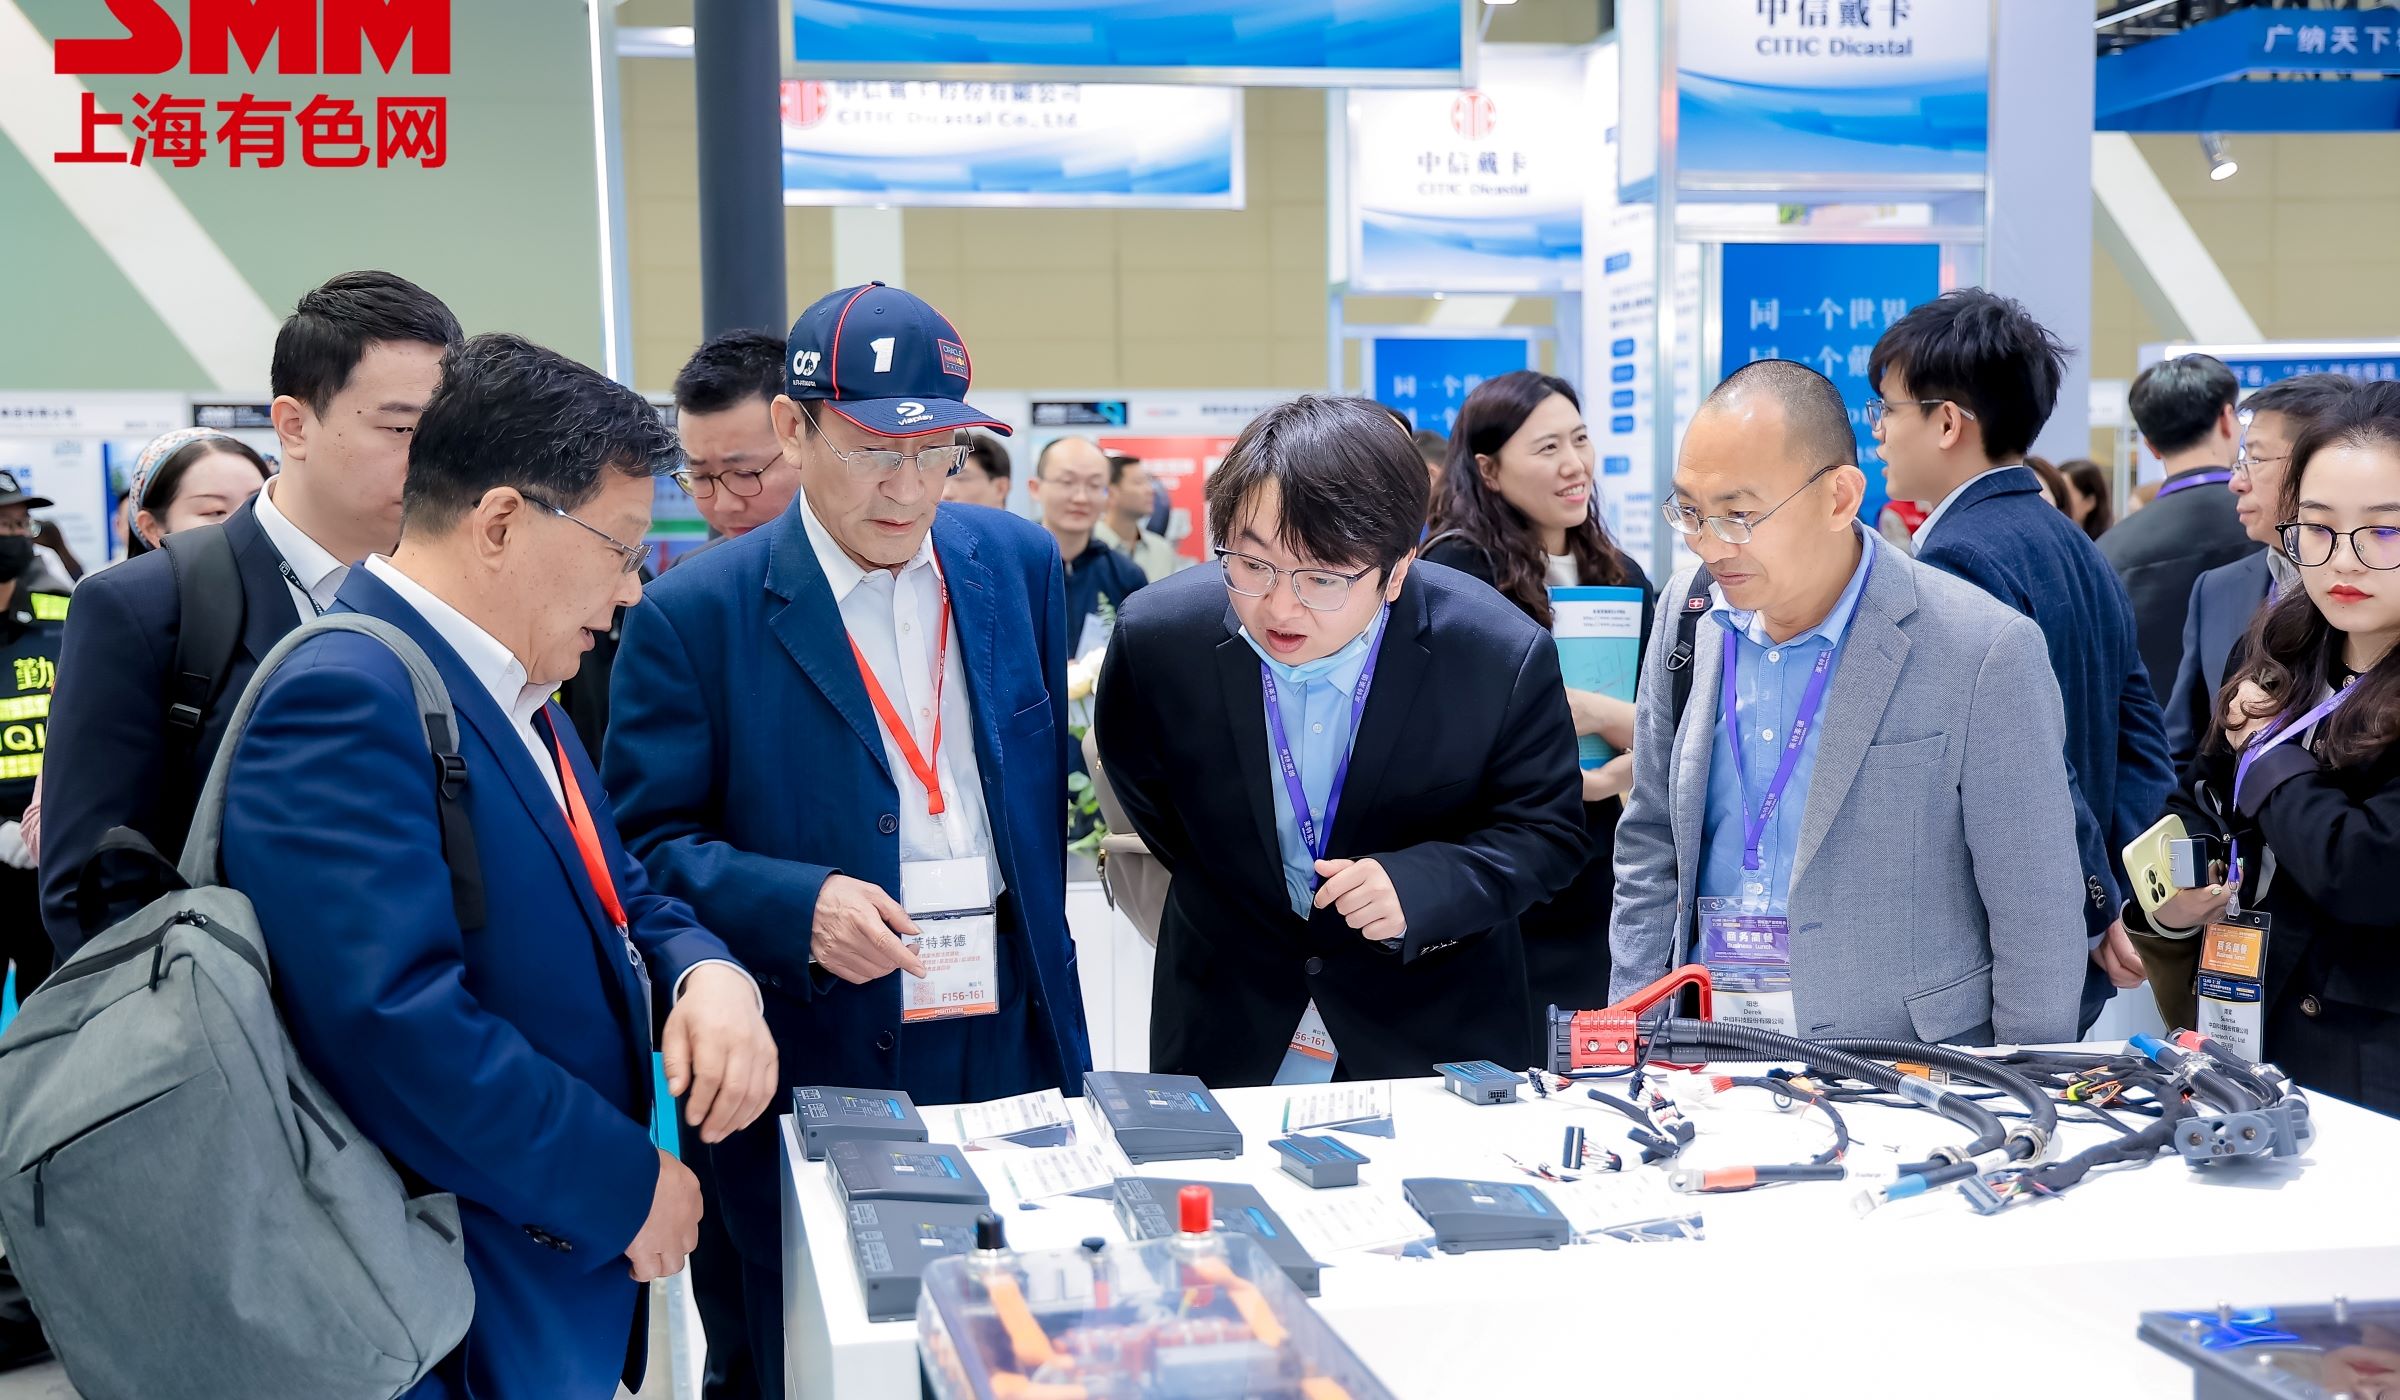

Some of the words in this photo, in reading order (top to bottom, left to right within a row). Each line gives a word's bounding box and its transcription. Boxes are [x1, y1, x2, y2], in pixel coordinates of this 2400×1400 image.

[1756, 0, 1912, 28] 中信戴卡
[1755, 36, 1821, 57] CITIC
[1829, 36, 1913, 57] Dicastal
[2264, 23, 2400, 55] 广纳天下
[869, 337, 896, 373] 1
[897, 414, 934, 427] viaplay
[13, 656, 56, 692] 勤
[942, 989, 985, 1002] F156-161
[1743, 1008, 1762, 1016] Derek
